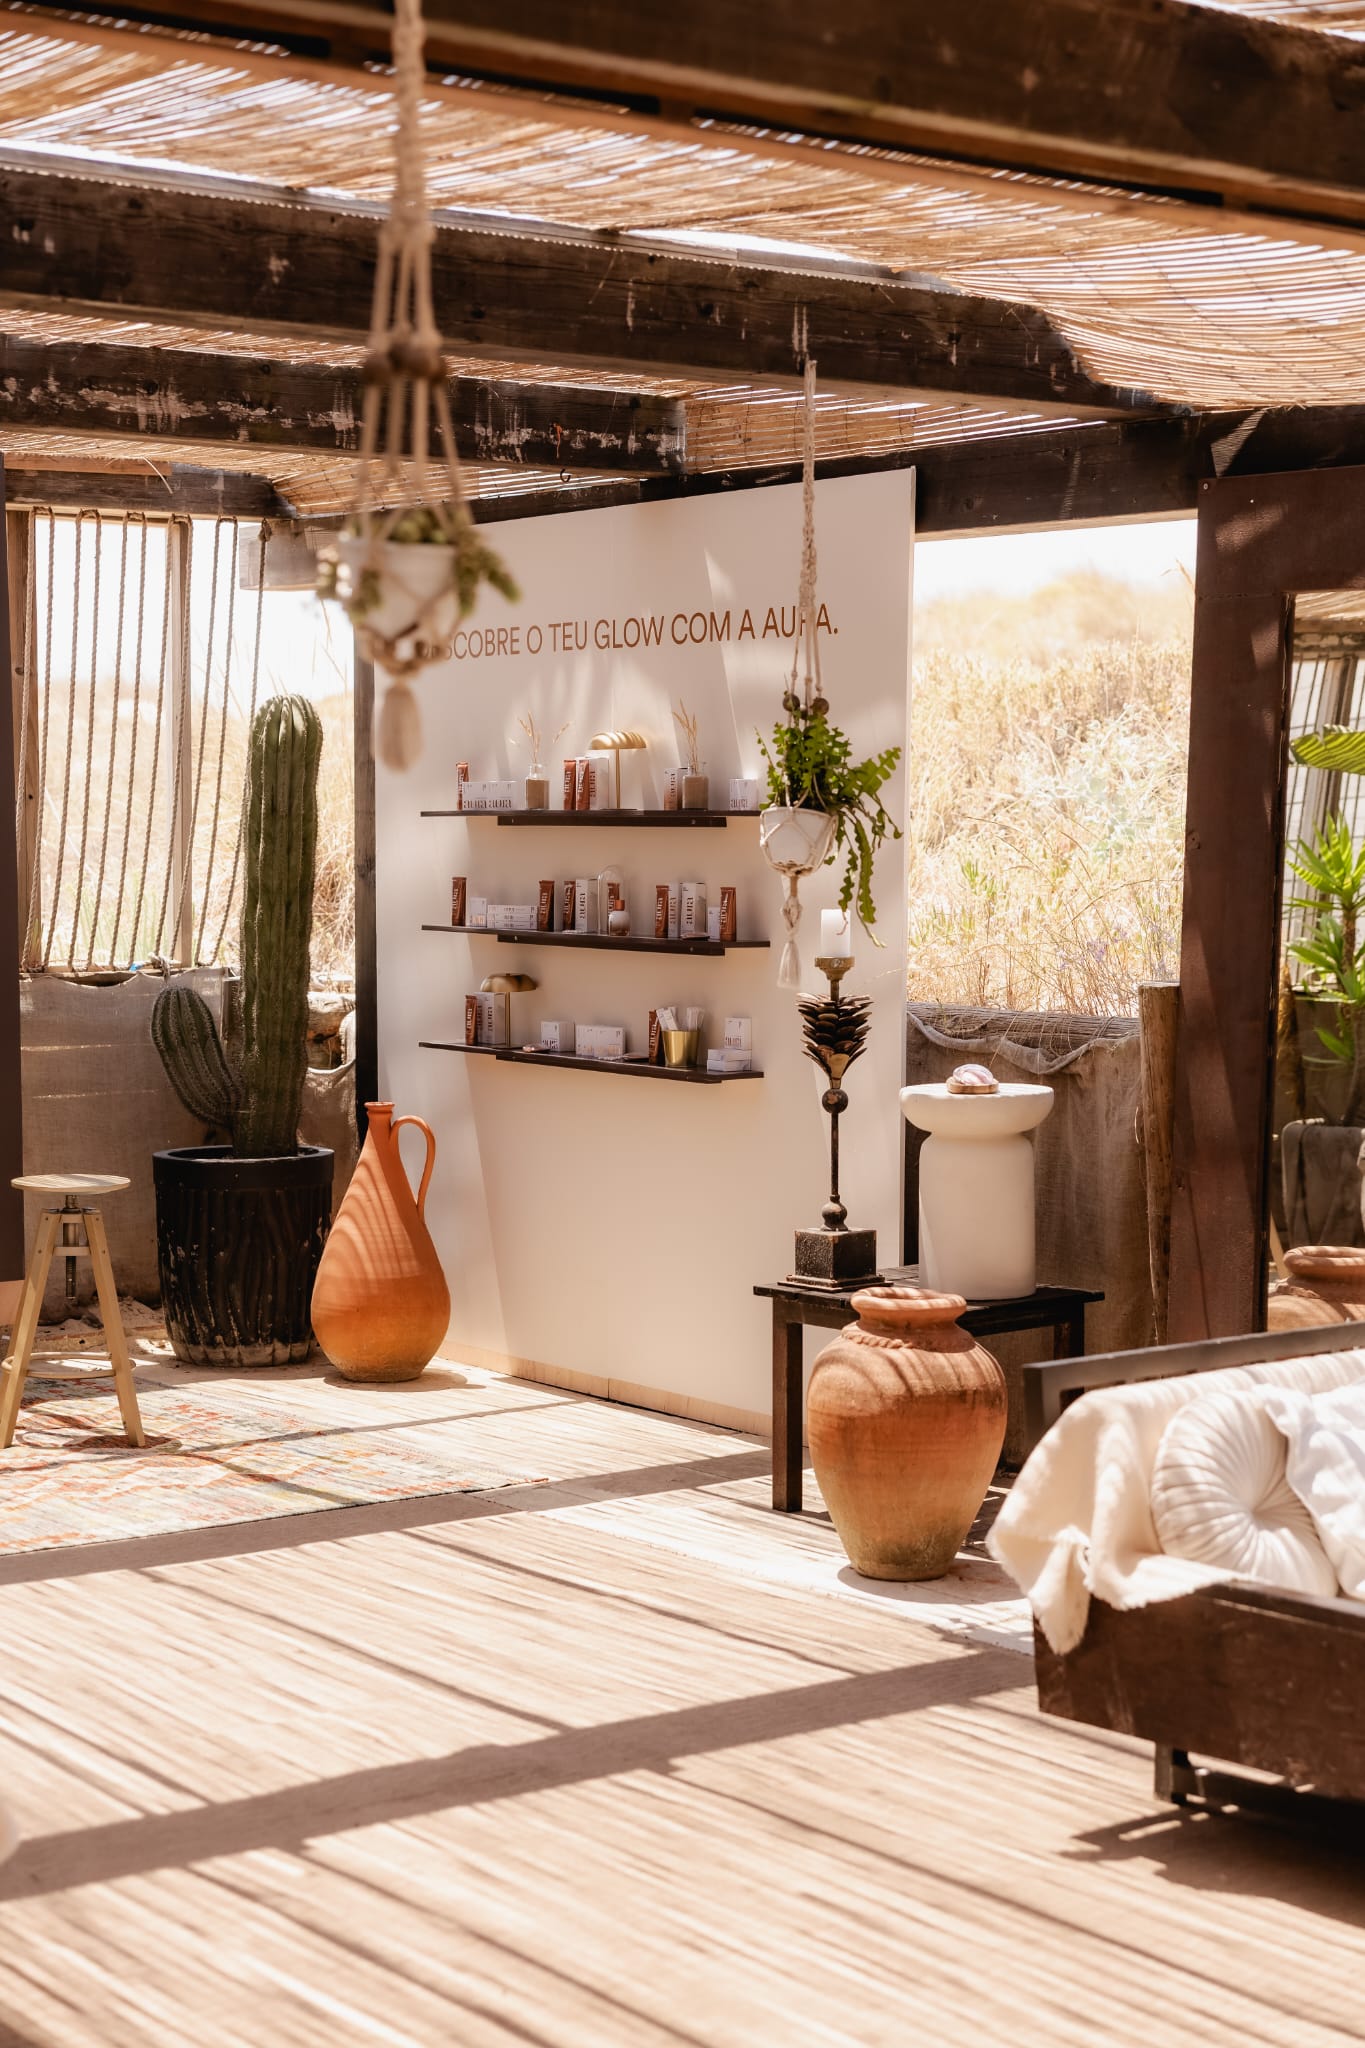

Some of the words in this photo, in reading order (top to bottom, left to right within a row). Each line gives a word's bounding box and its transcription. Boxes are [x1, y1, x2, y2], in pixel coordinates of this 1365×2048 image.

[526, 625, 543, 655] O
[548, 619, 588, 652] TEU
[594, 615, 664, 650] GLOW
[671, 610, 731, 645] COM
[738, 609, 756, 640] A
